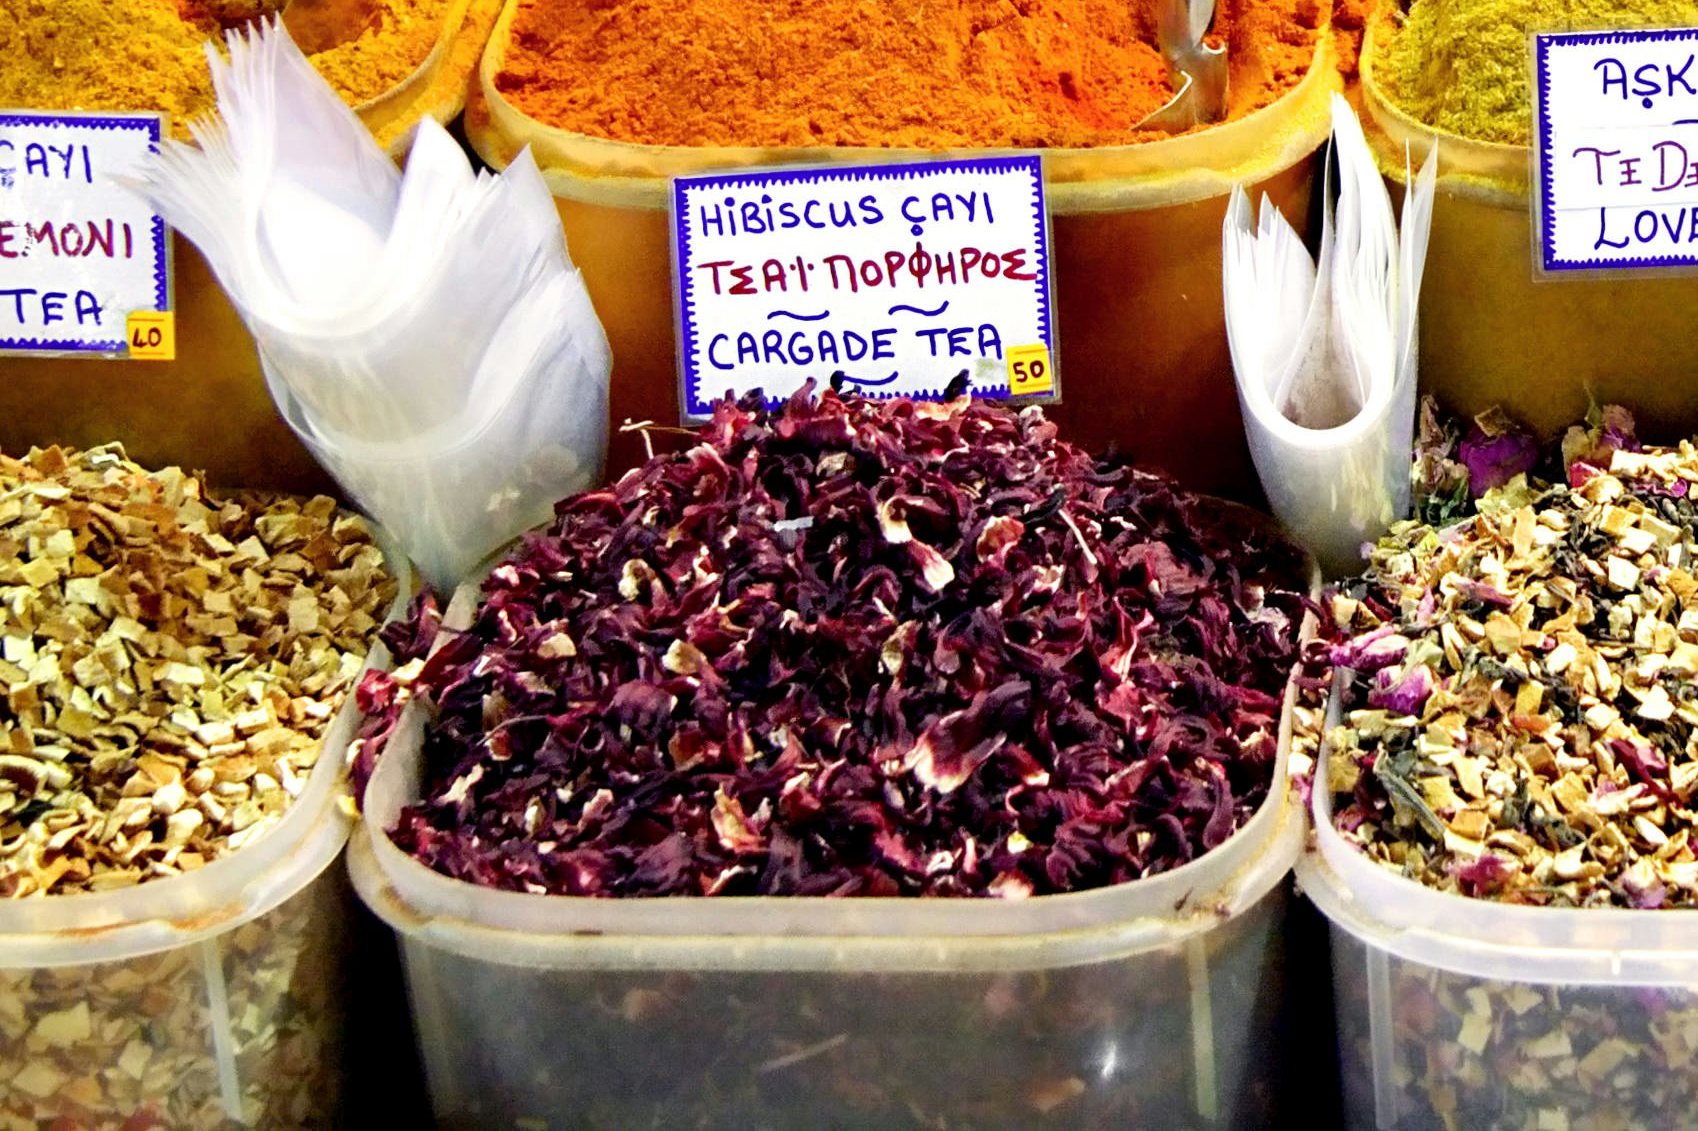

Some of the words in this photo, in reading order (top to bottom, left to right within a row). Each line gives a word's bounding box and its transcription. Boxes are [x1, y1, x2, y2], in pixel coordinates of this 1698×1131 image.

[1593, 54, 1698, 109] AŞK
[900, 190, 994, 237] ÇAYI
[0, 288, 103, 326] TEA
[131, 327, 163, 349] 40
[708, 327, 898, 370] CARGADE
[915, 323, 1003, 361] TEA
[1012, 359, 1045, 384] 50
